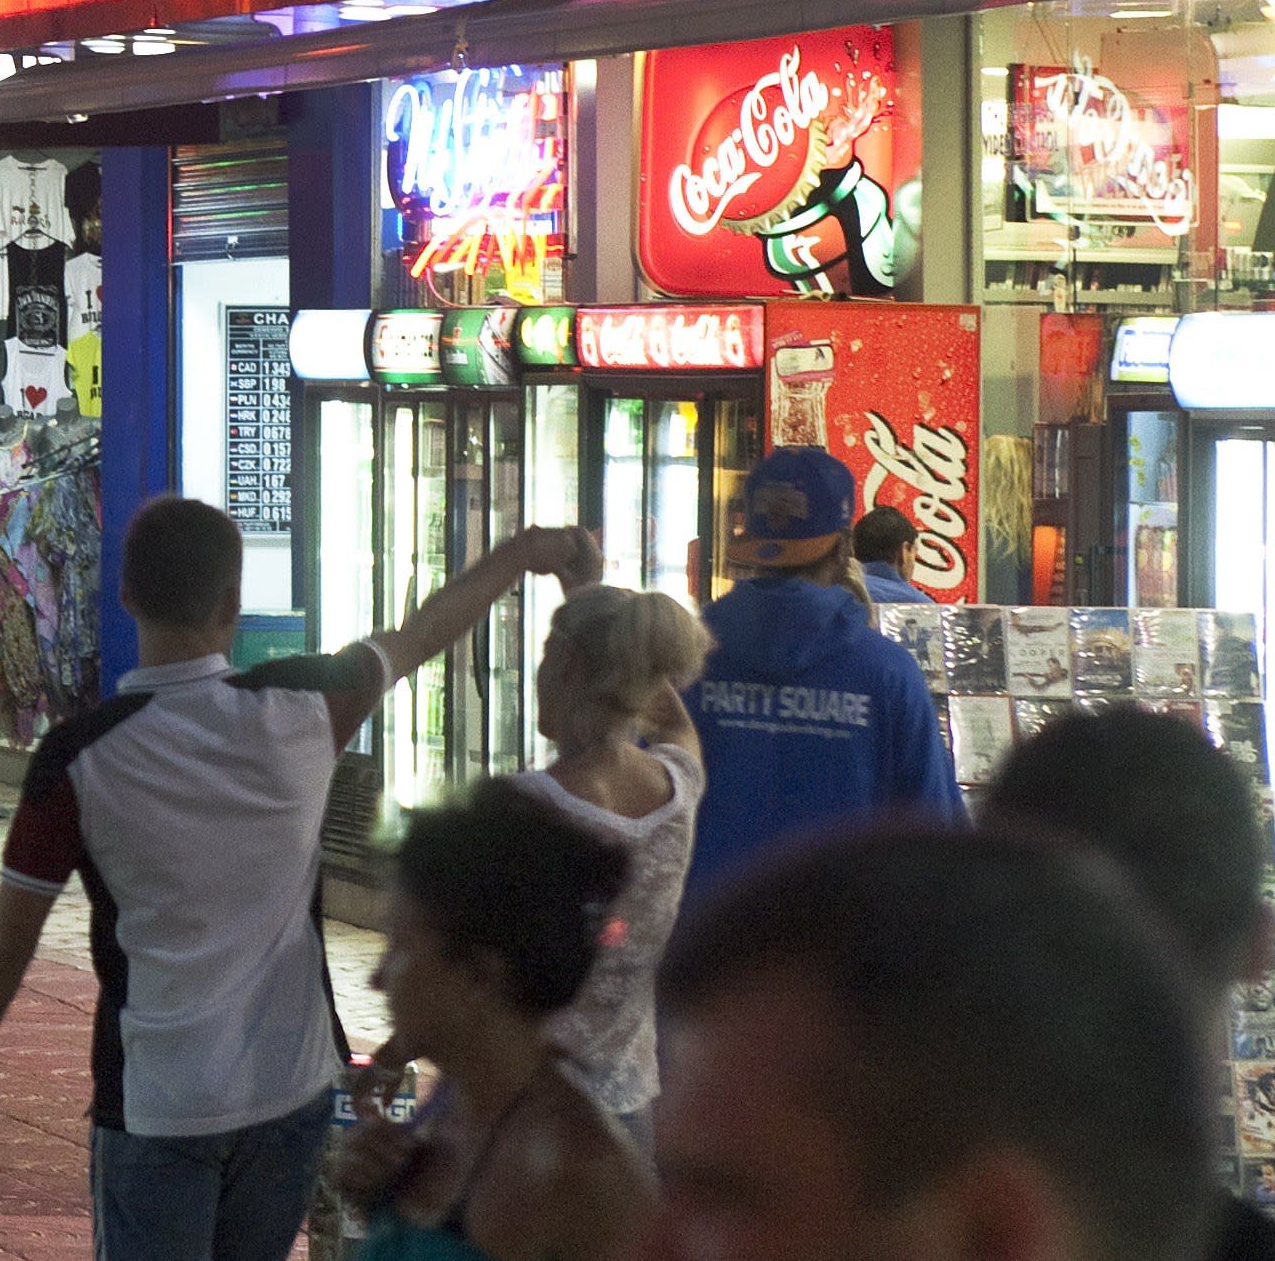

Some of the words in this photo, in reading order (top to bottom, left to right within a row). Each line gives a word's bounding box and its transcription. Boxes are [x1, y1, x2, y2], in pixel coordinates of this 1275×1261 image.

[669, 44, 829, 236] Coca-Cola
[237, 362, 258, 374] CAD
[701, 680, 774, 716] PARTY
[777, 688, 872, 727] SQUARE
